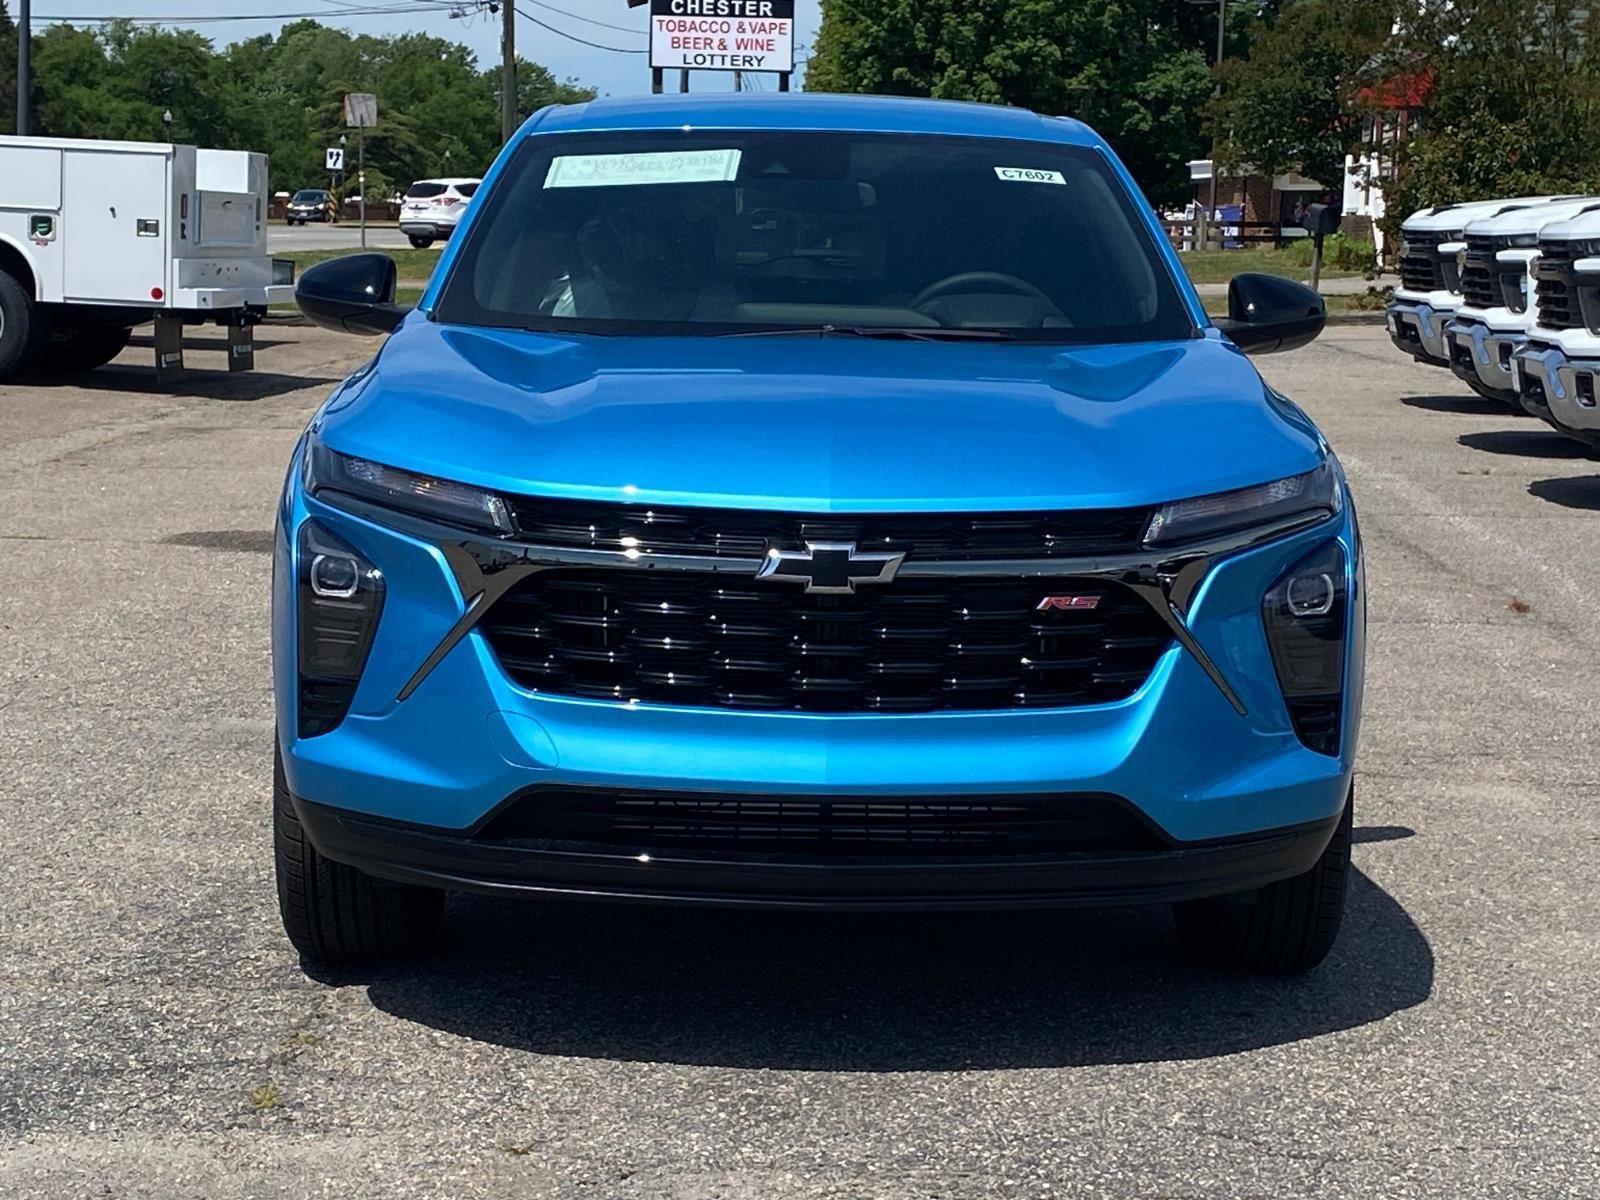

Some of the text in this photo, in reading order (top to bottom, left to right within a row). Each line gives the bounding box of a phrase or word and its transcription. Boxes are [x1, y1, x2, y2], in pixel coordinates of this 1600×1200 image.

[671, 0, 773, 16] CHESTER
[657, 19, 787, 35] TOBACCO & VAPE
[671, 36, 776, 52] BEER & WINE
[683, 53, 765, 66] LOTTERY
[1036, 596, 1101, 610] RS
